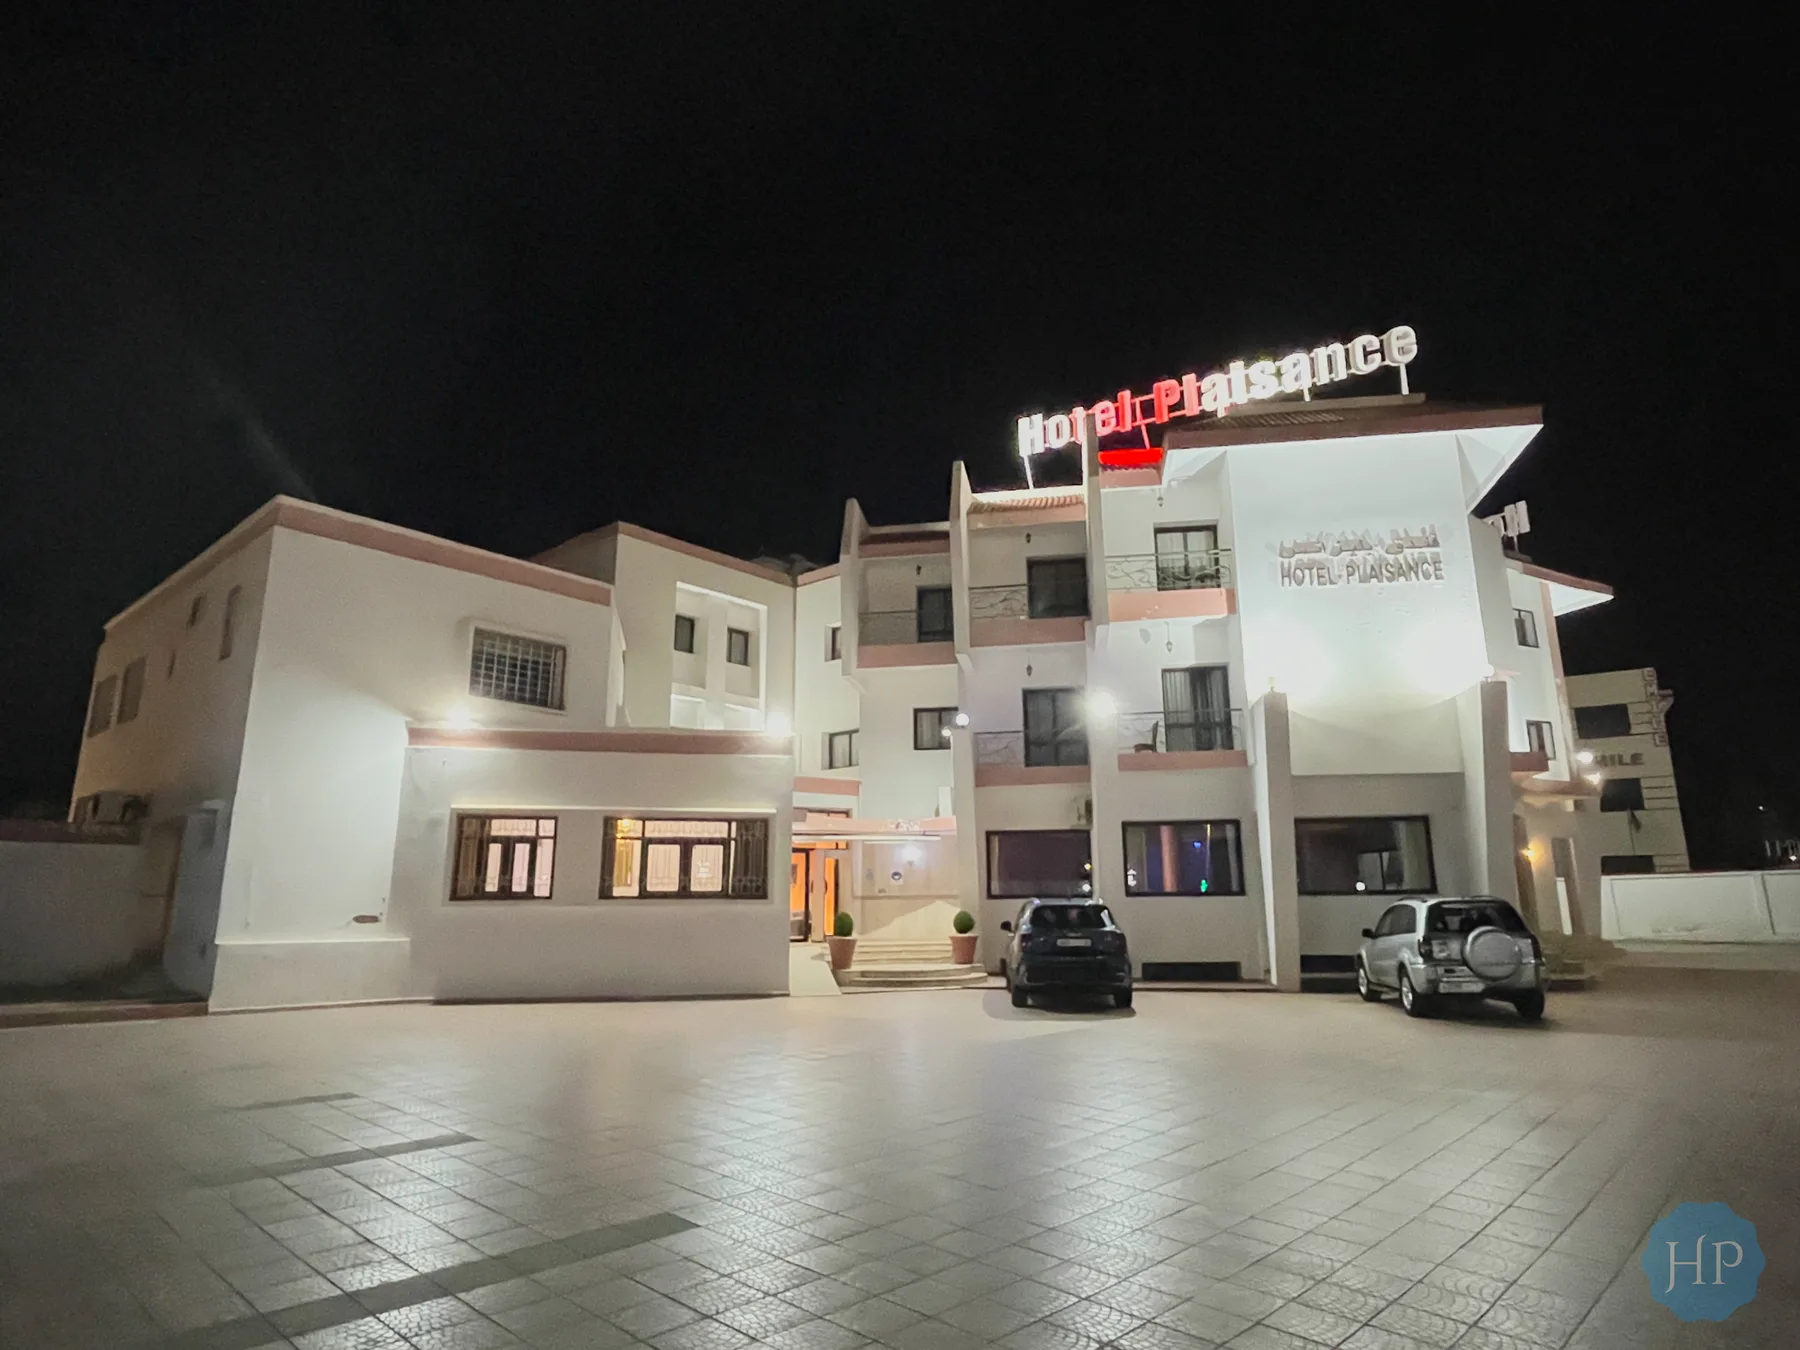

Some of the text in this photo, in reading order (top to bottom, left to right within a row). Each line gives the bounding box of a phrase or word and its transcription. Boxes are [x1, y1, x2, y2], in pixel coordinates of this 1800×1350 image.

[1018, 325, 1418, 457] Hotel Plaisance
[1280, 560, 1444, 587] HOTEL PLAISANCE
